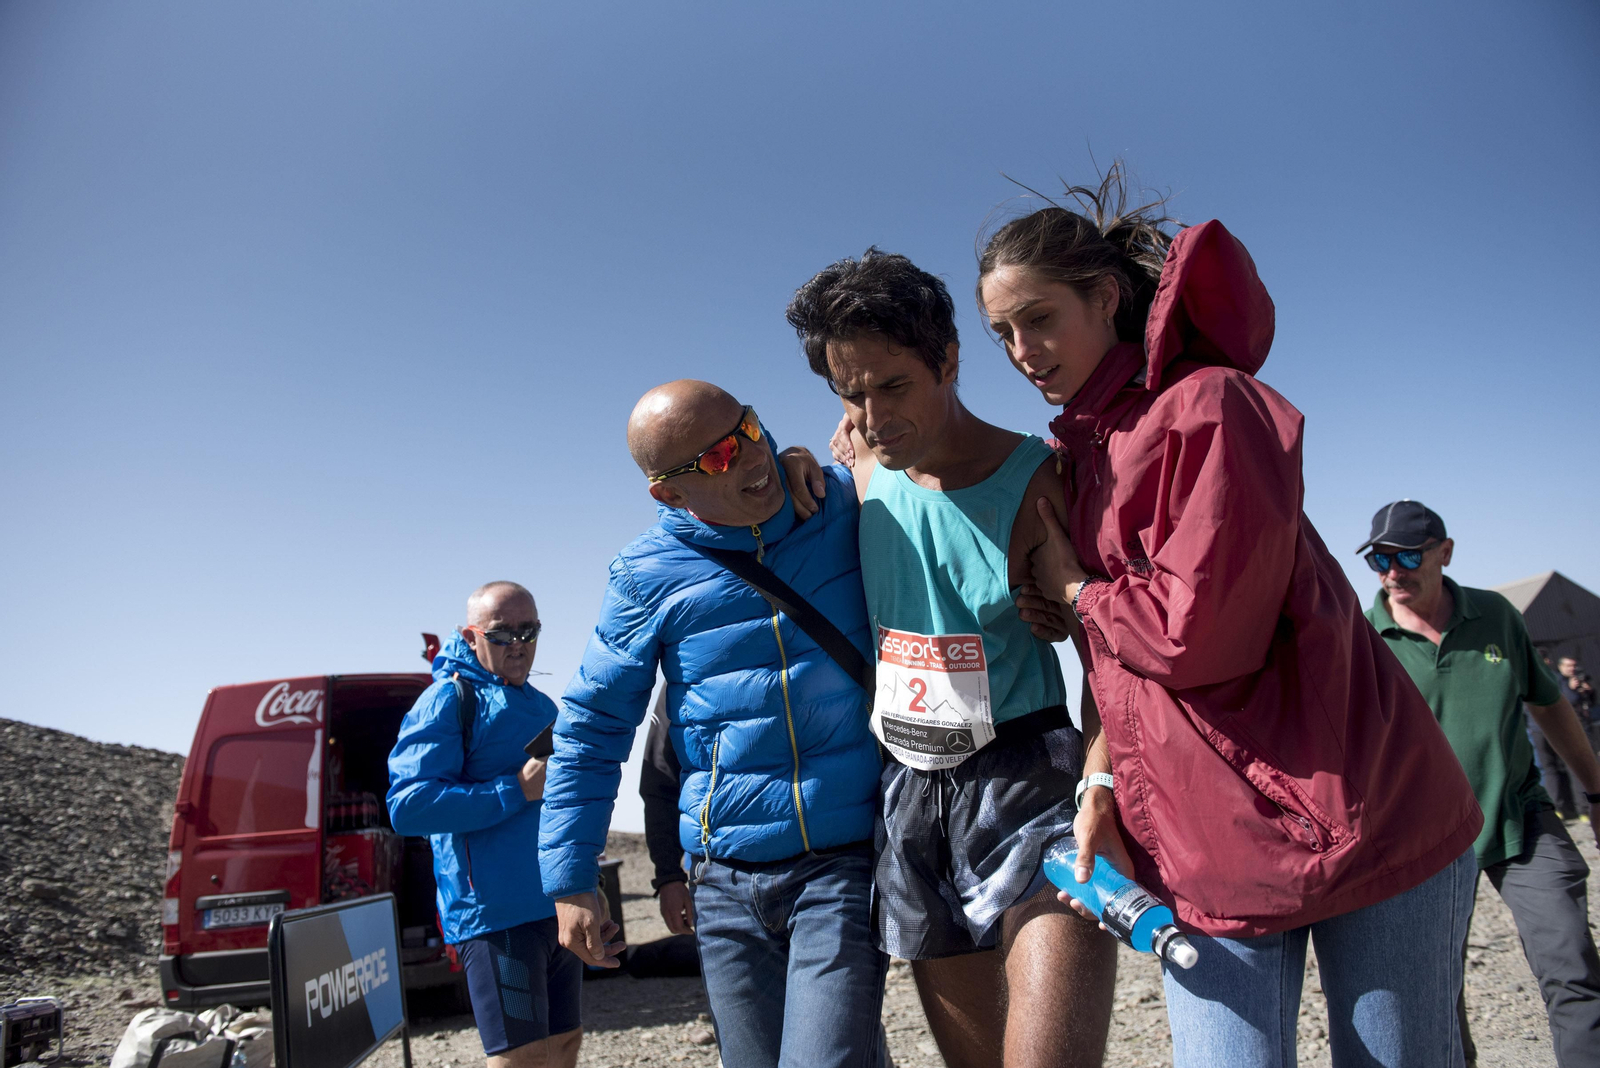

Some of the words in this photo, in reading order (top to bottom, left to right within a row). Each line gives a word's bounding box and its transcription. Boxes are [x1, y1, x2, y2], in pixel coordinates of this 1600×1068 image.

[929, 661, 944, 670] TRAIL
[949, 662, 981, 670] OUTDOOR
[908, 677, 927, 713] 2
[883, 720, 928, 738] Mercedes-Benz
[885, 732, 910, 748] Granada
[910, 740, 945, 753] Premium
[904, 750, 944, 765] GRANADA-PICO
[212, 906, 249, 924] 5033
[304, 947, 389, 1028] POWERADE
